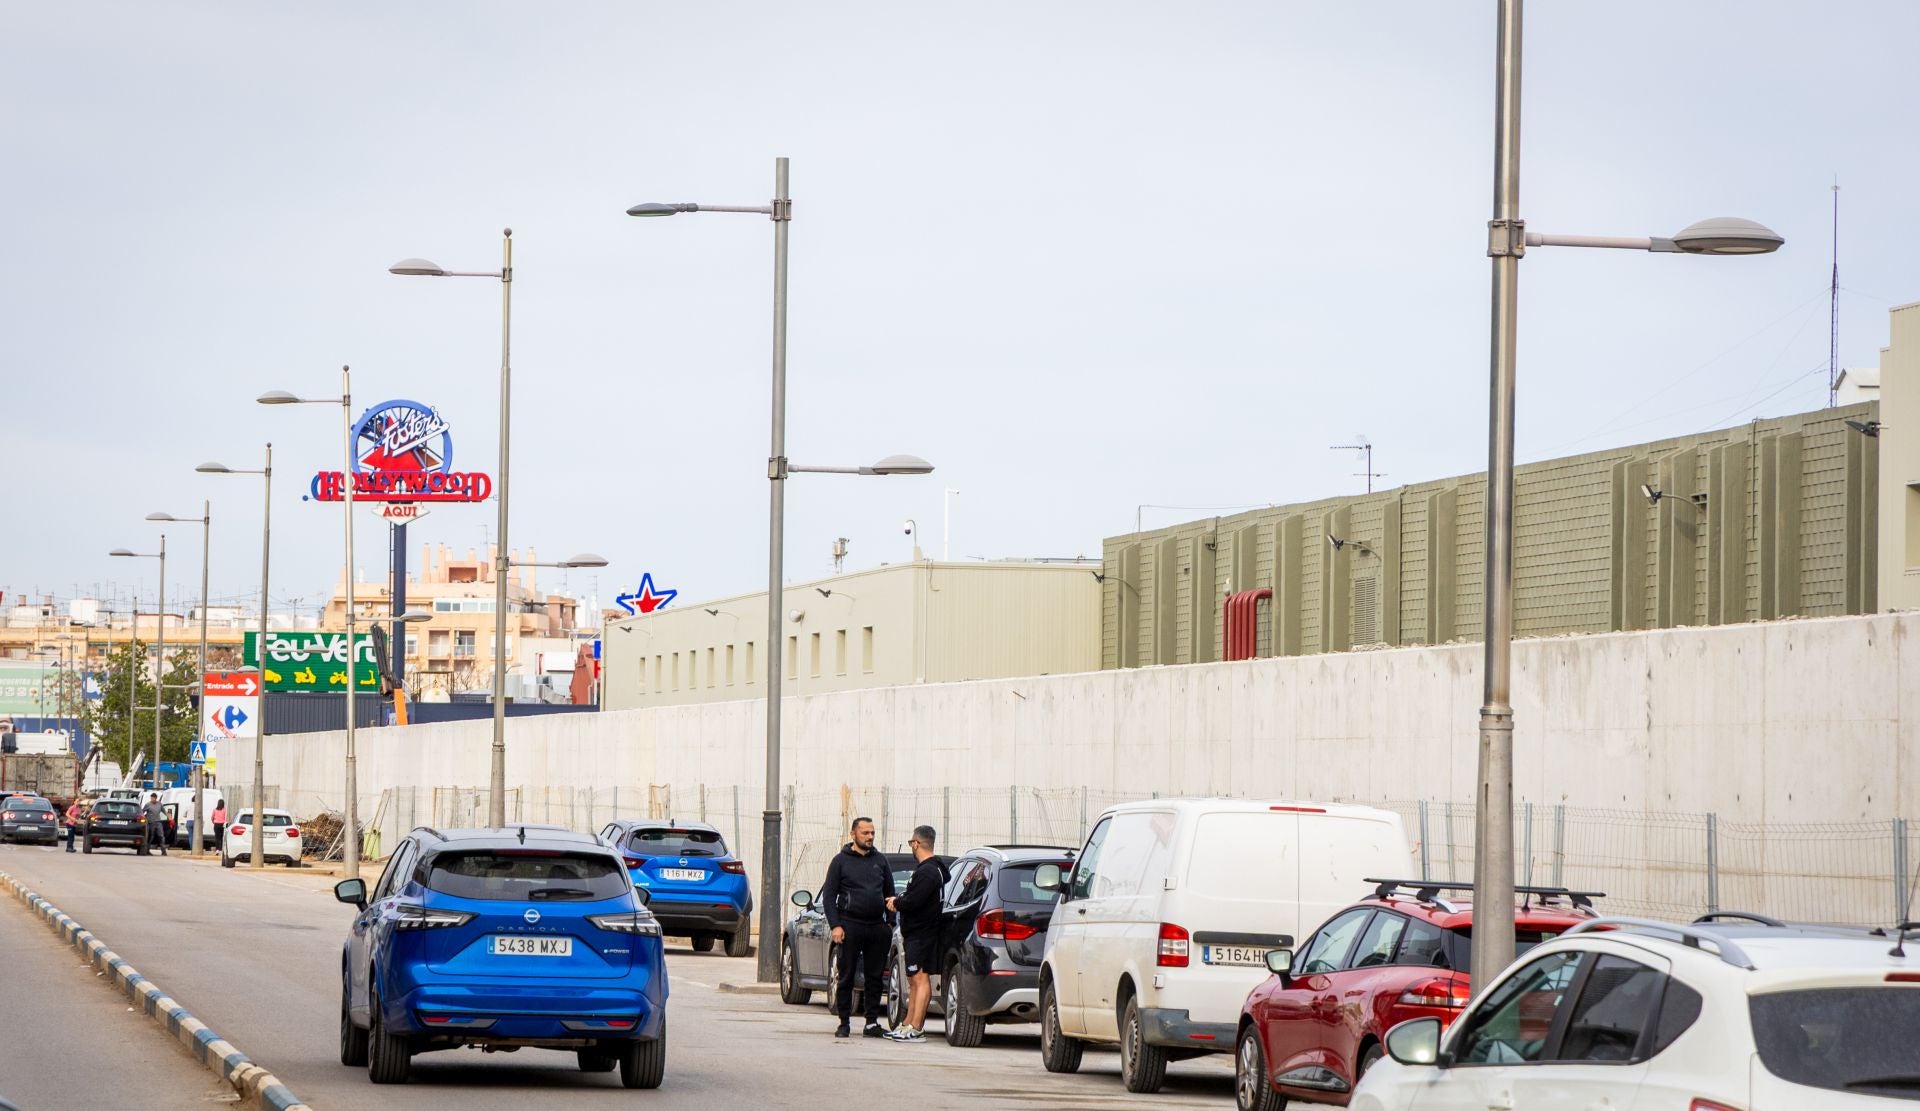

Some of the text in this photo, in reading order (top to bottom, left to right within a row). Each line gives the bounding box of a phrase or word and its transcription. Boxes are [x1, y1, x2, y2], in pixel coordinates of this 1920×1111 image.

[317, 471, 492, 502] HOLLYWOOD
[382, 506, 418, 518] AQUI
[255, 633, 378, 662] Feu Vert
[499, 938, 568, 954] 5438 MXJ
